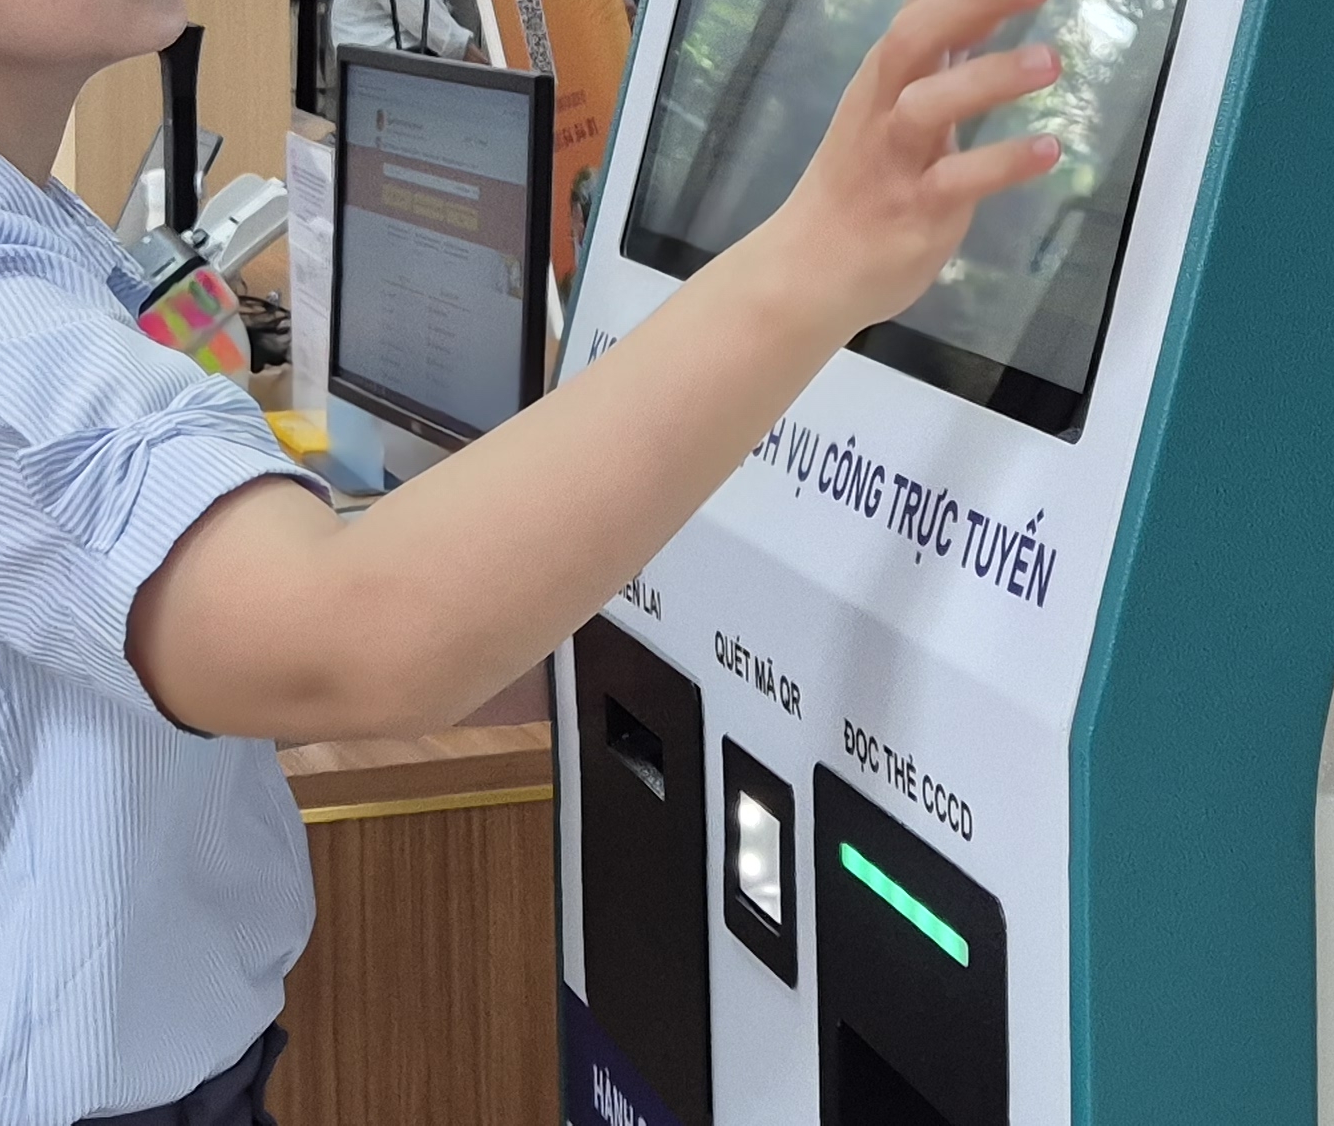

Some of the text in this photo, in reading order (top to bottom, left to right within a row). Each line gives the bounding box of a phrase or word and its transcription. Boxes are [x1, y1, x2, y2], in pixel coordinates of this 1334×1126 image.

[787, 421, 820, 499] VỤ
[818, 434, 886, 519] CÔNG
[886, 472, 959, 565] TRỰC
[961, 507, 1057, 609] TUYẾN
[643, 582, 662, 622] LAI
[714, 630, 803, 721] QUÉT MÃ QR
[843, 717, 973, 842] ĐỌC THẺ CCCD
